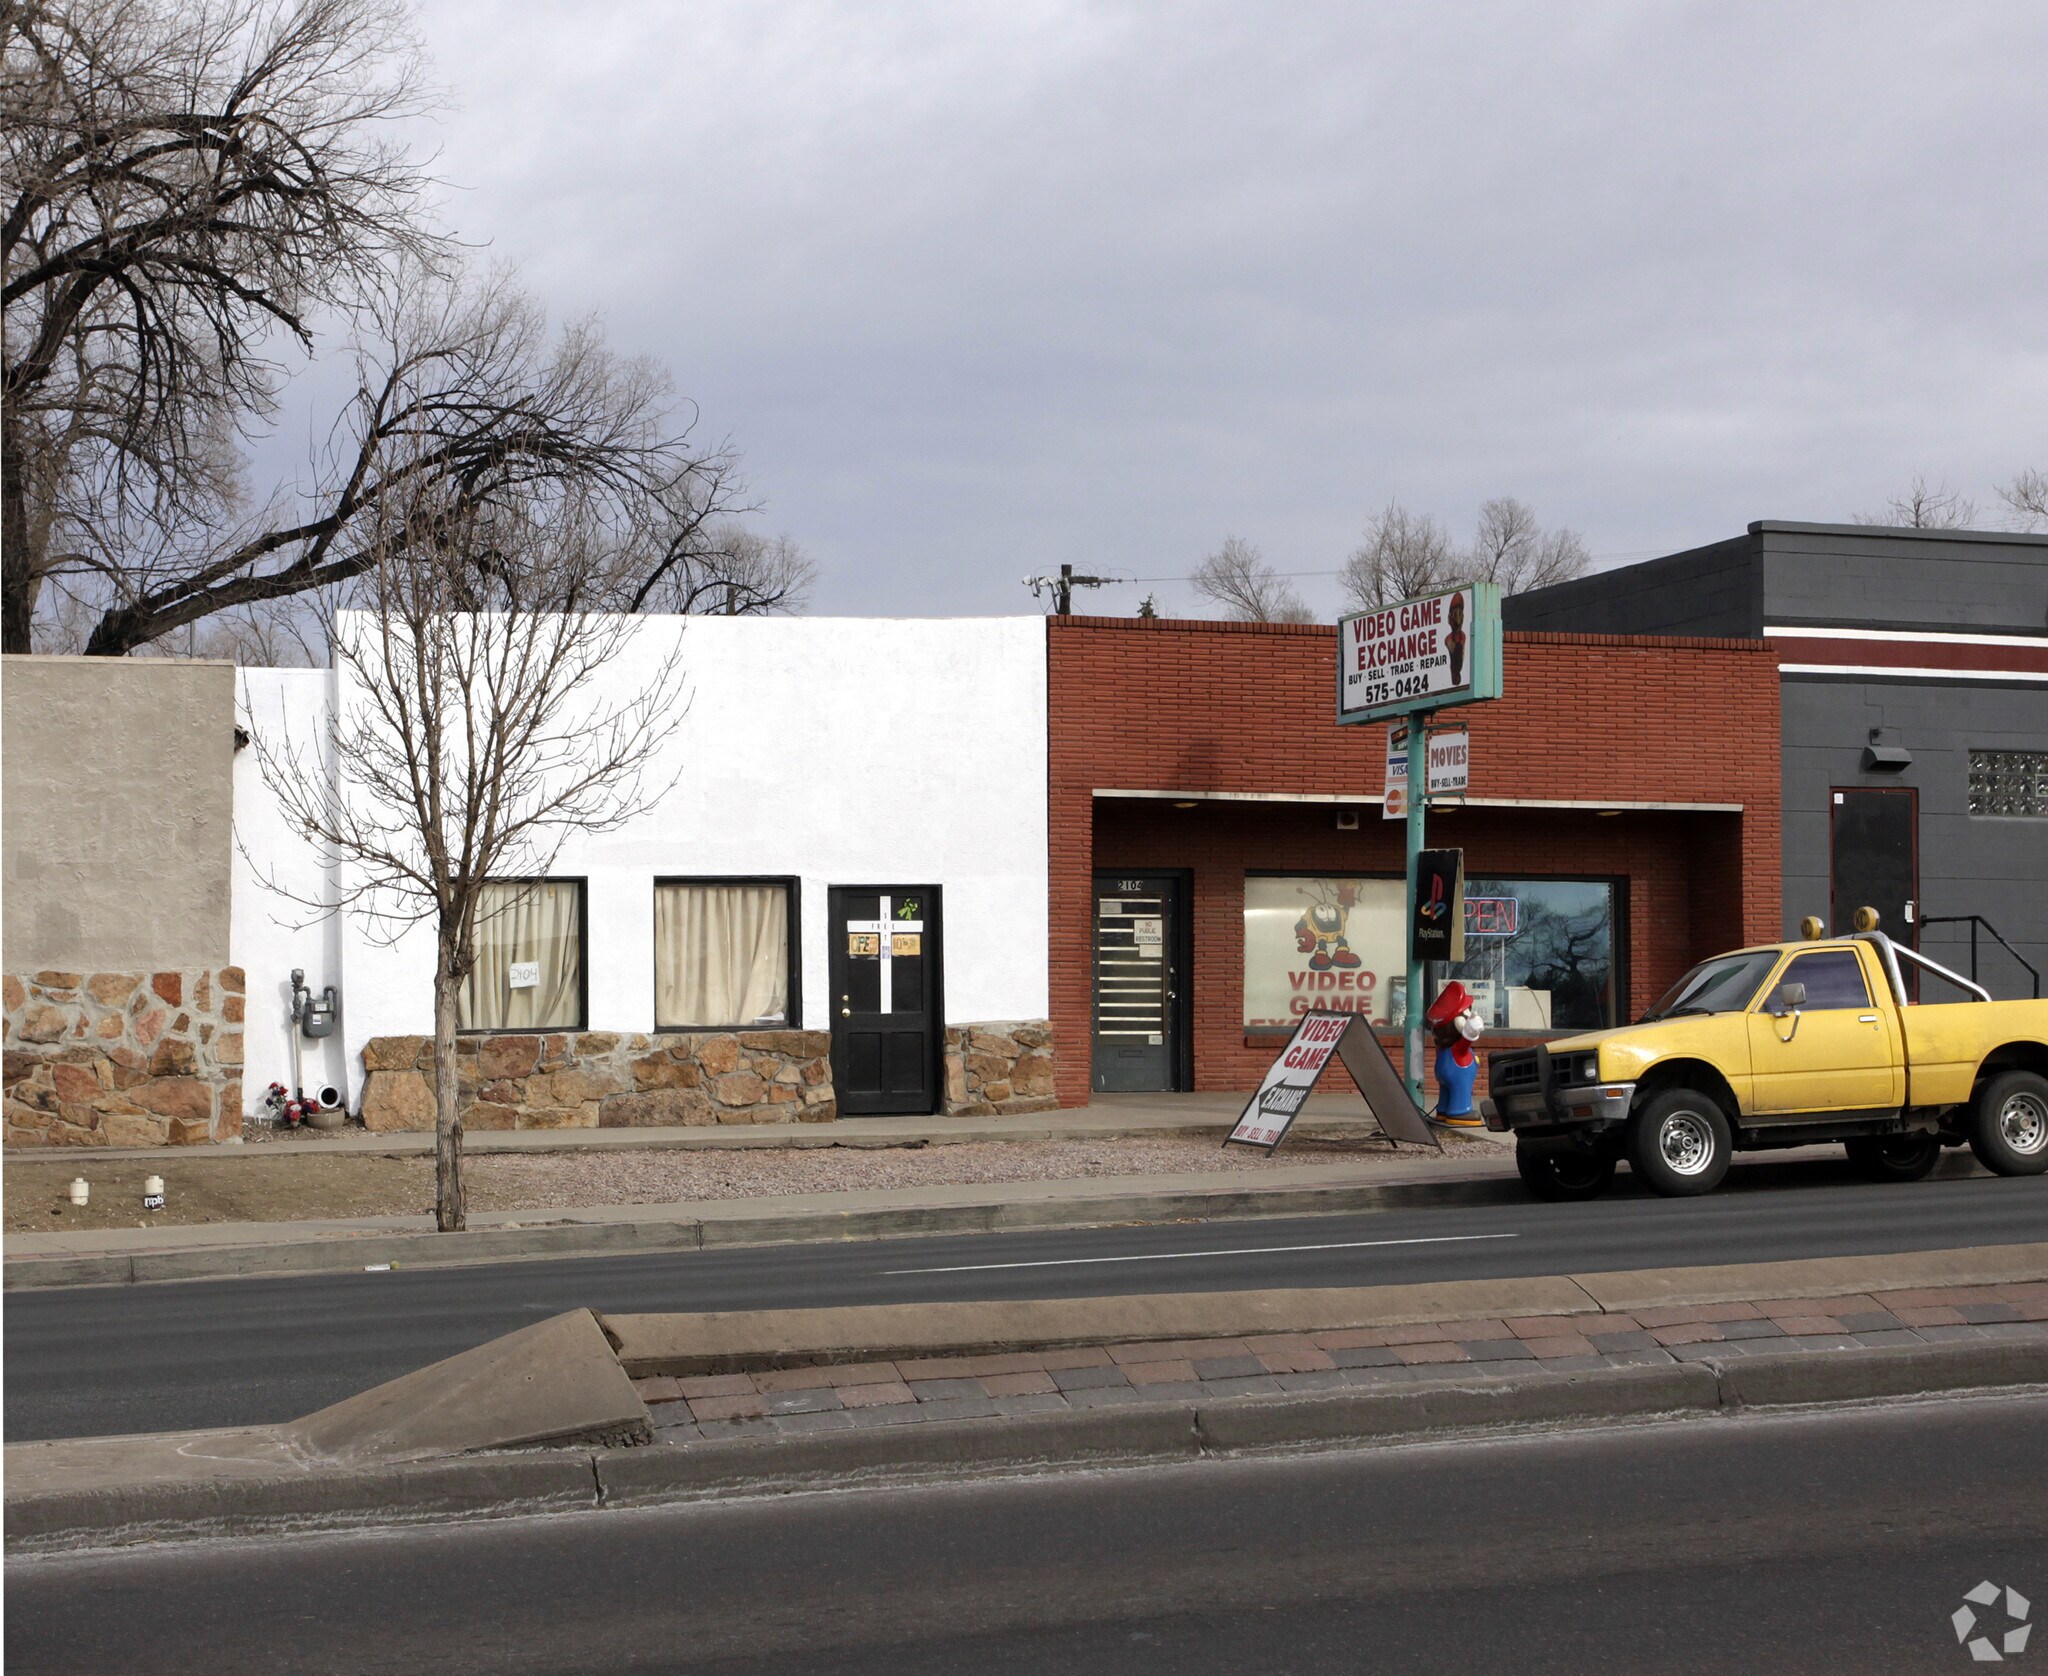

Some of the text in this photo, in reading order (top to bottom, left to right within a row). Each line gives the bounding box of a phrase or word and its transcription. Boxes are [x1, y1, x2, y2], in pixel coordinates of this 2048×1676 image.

[1353, 599, 1441, 643] VIDEO GAME
[1358, 629, 1437, 671] EXCHANGE
[1349, 655, 1447, 685] BUY SELL TRADE REPAIR
[1365, 674, 1429, 703] 575-0424
[1431, 745, 1466, 768] MOVIES
[1464, 900, 1514, 932] PEN
[1288, 971, 1376, 991] VIDEO
[1289, 995, 1373, 1015] GAME
[1300, 1019, 1346, 1042] VIDEO
[1284, 1046, 1330, 1070] GAME
